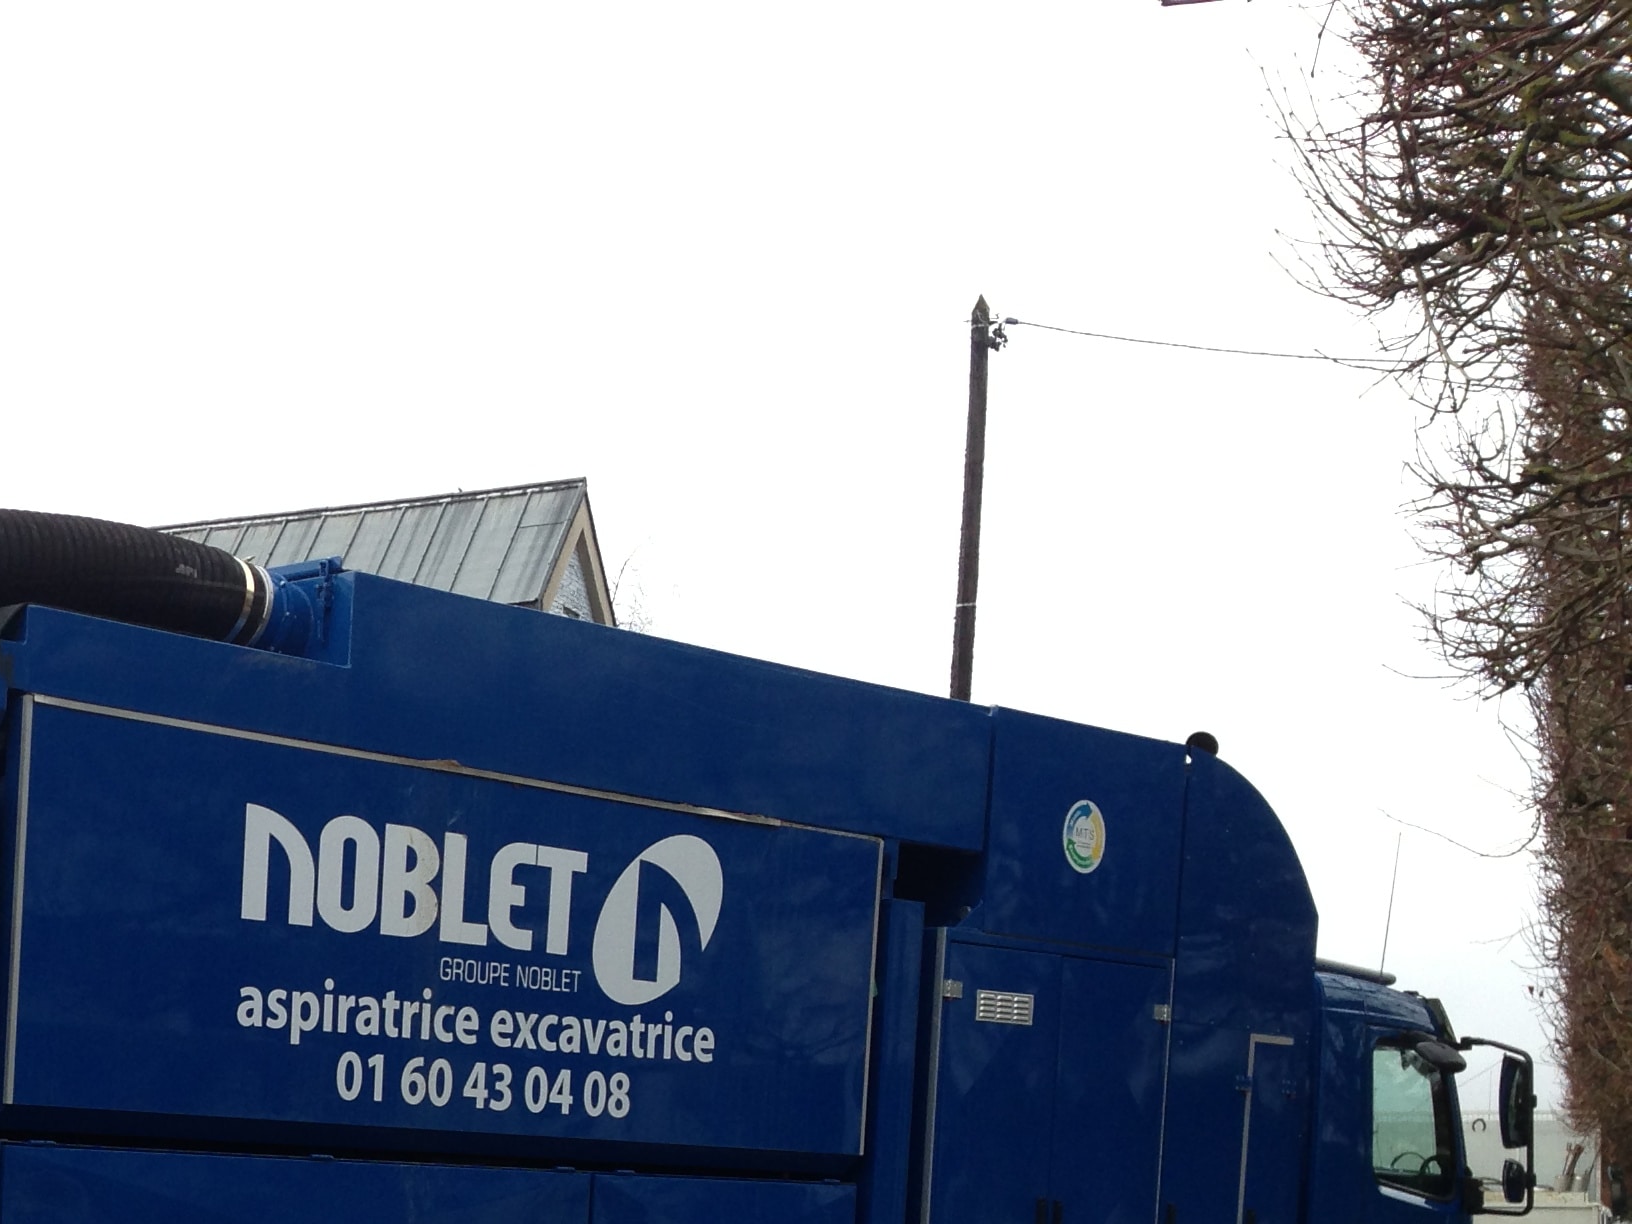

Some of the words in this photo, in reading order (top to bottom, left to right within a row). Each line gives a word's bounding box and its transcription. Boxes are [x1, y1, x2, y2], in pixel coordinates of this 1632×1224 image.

[241, 802, 589, 956] NOBLET
[439, 957, 510, 987] GROUPE
[516, 965, 582, 993] NOBLET
[236, 979, 480, 1045] aspiratrice
[490, 1009, 715, 1063] excavatrice
[336, 1051, 385, 1102] 01
[400, 1056, 453, 1107] 60
[462, 1062, 513, 1111] 43
[524, 1066, 574, 1115] 04
[583, 1070, 631, 1119] 08
